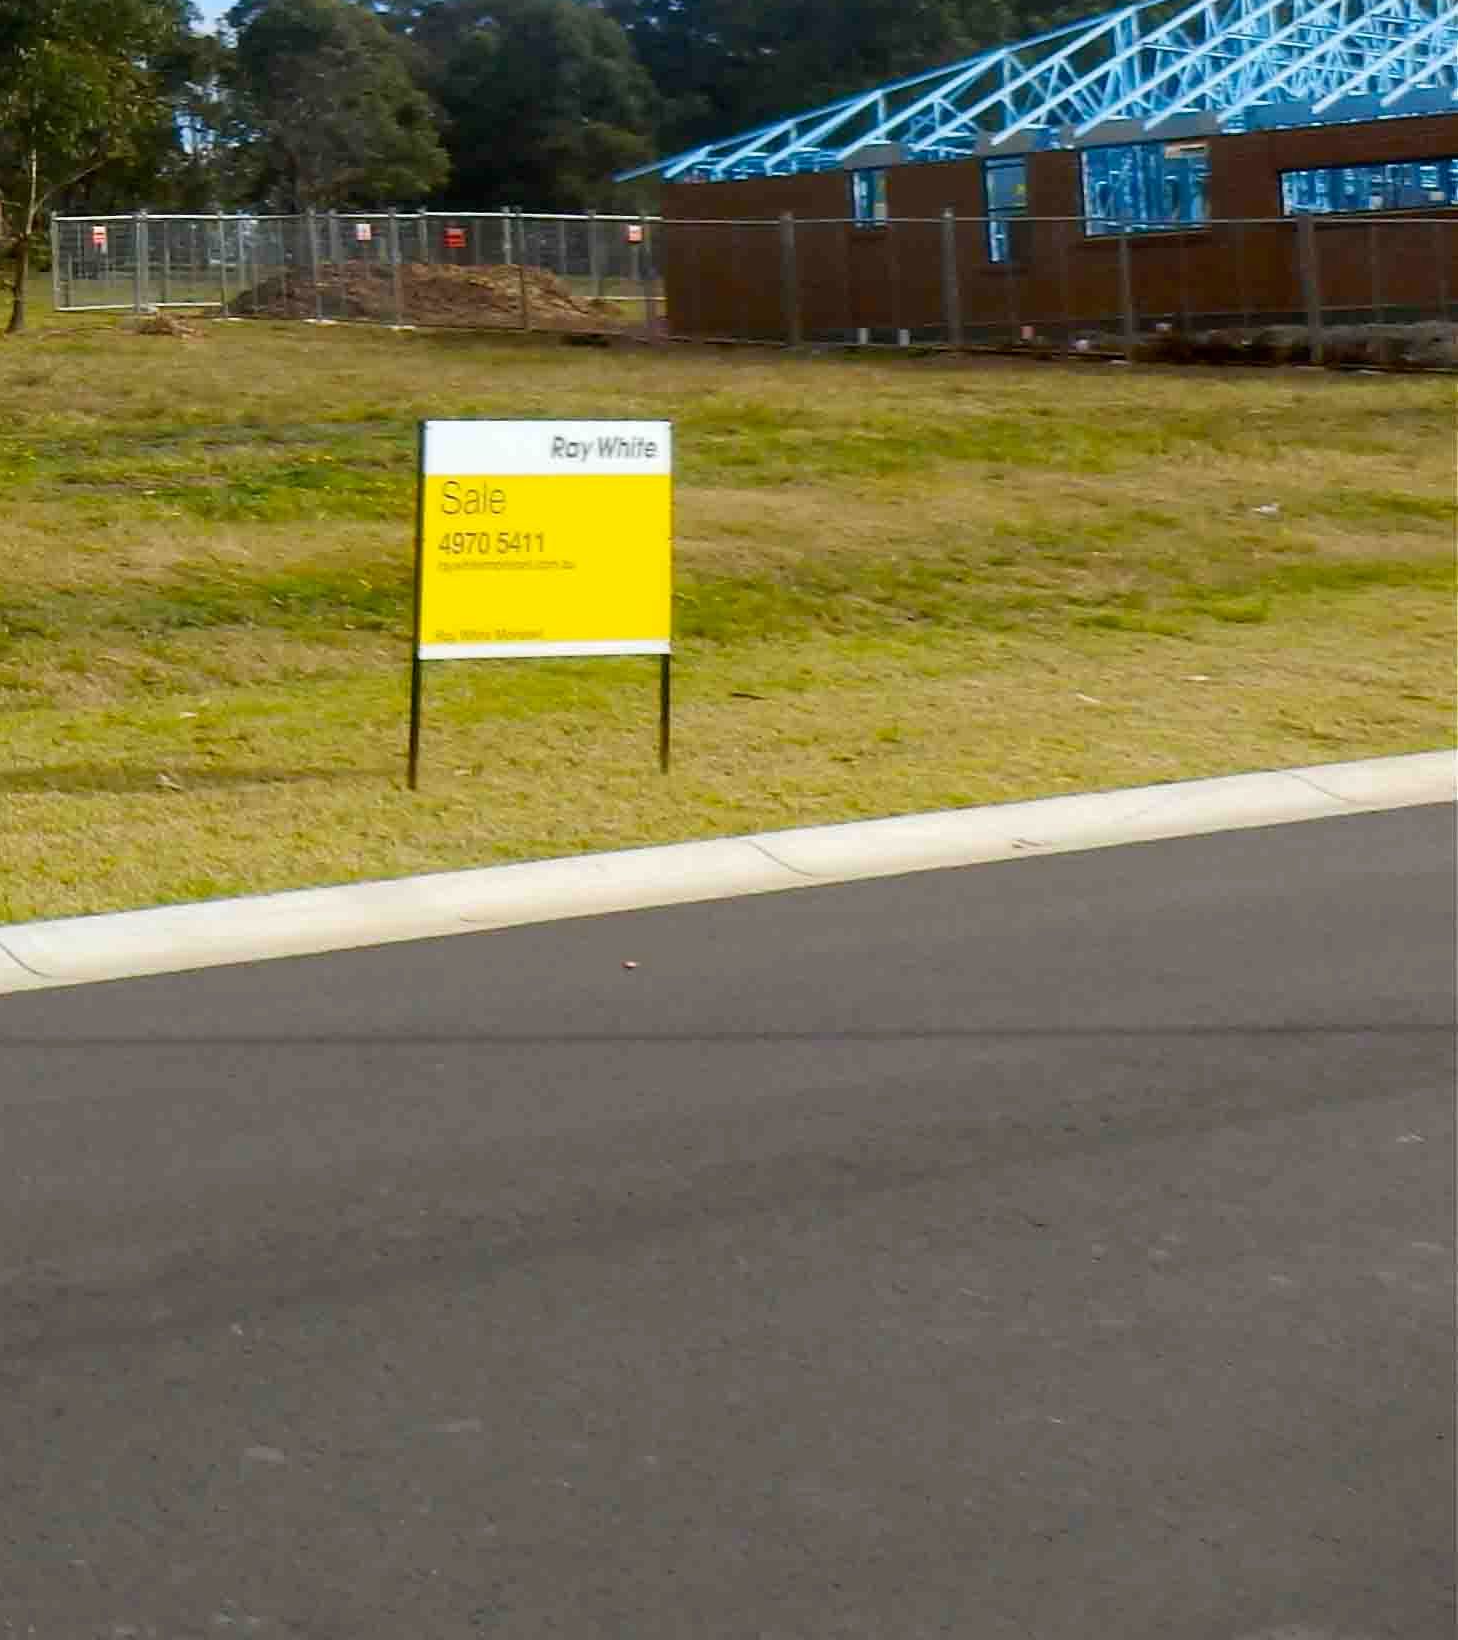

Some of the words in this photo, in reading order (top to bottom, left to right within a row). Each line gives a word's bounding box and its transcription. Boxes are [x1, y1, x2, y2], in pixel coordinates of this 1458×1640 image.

[551, 436, 592, 461] Ray
[597, 437, 658, 458] White
[441, 480, 506, 514] Sale
[439, 532, 490, 554] 4970
[497, 532, 545, 553] 5411
